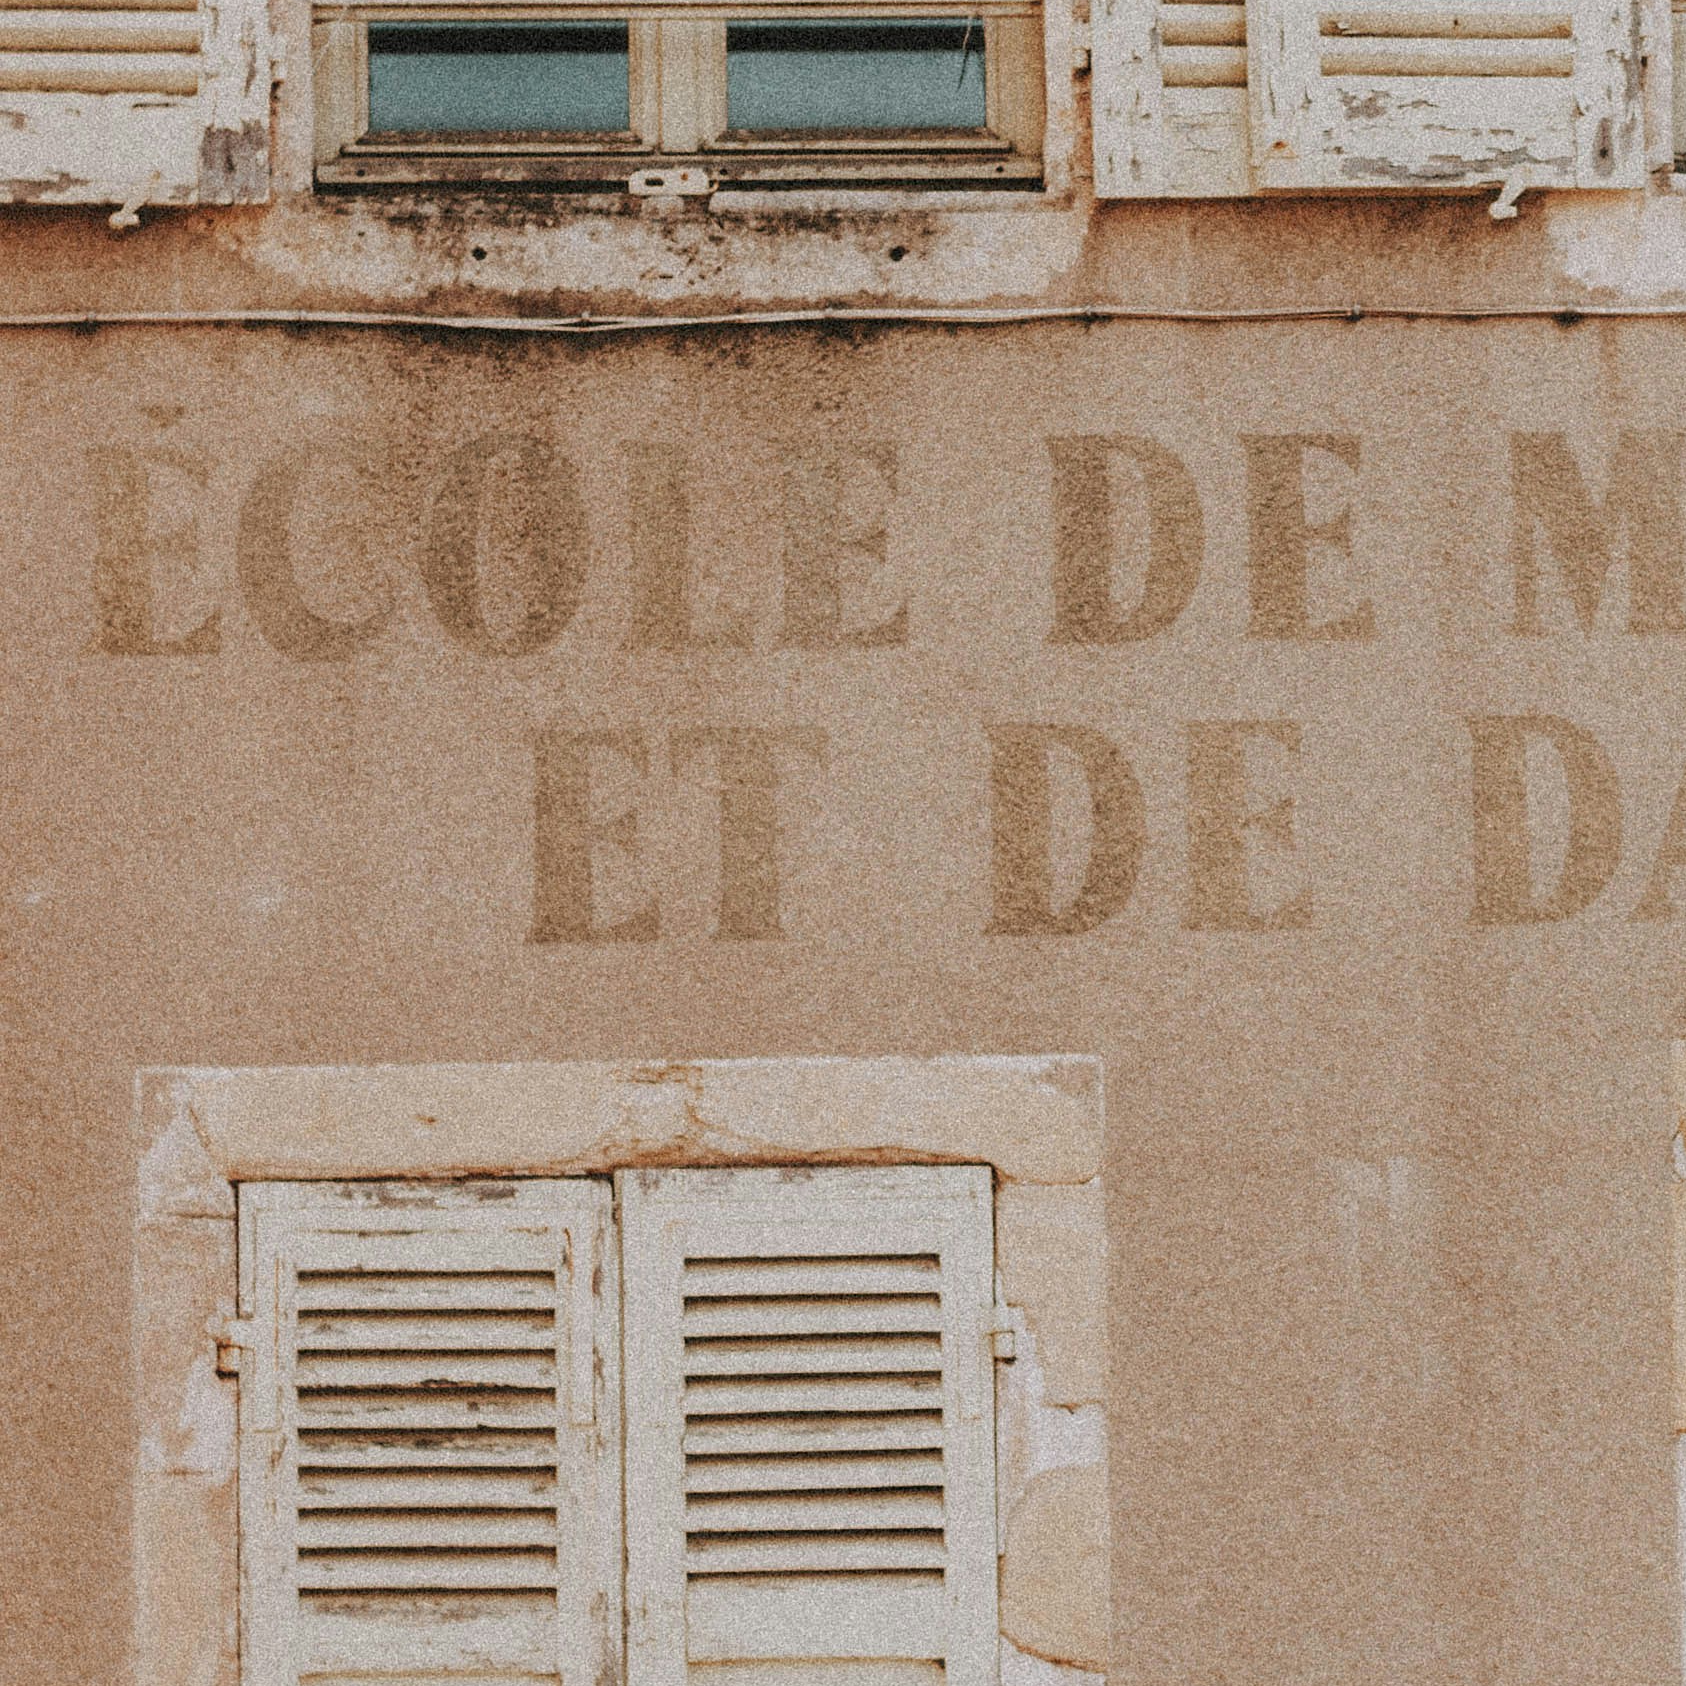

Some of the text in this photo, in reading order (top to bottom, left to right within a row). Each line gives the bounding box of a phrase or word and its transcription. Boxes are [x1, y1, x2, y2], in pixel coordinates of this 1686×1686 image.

[1044, 433, 1376, 643] DE
[524, 725, 828, 945] ET
[982, 721, 1314, 937] DE
